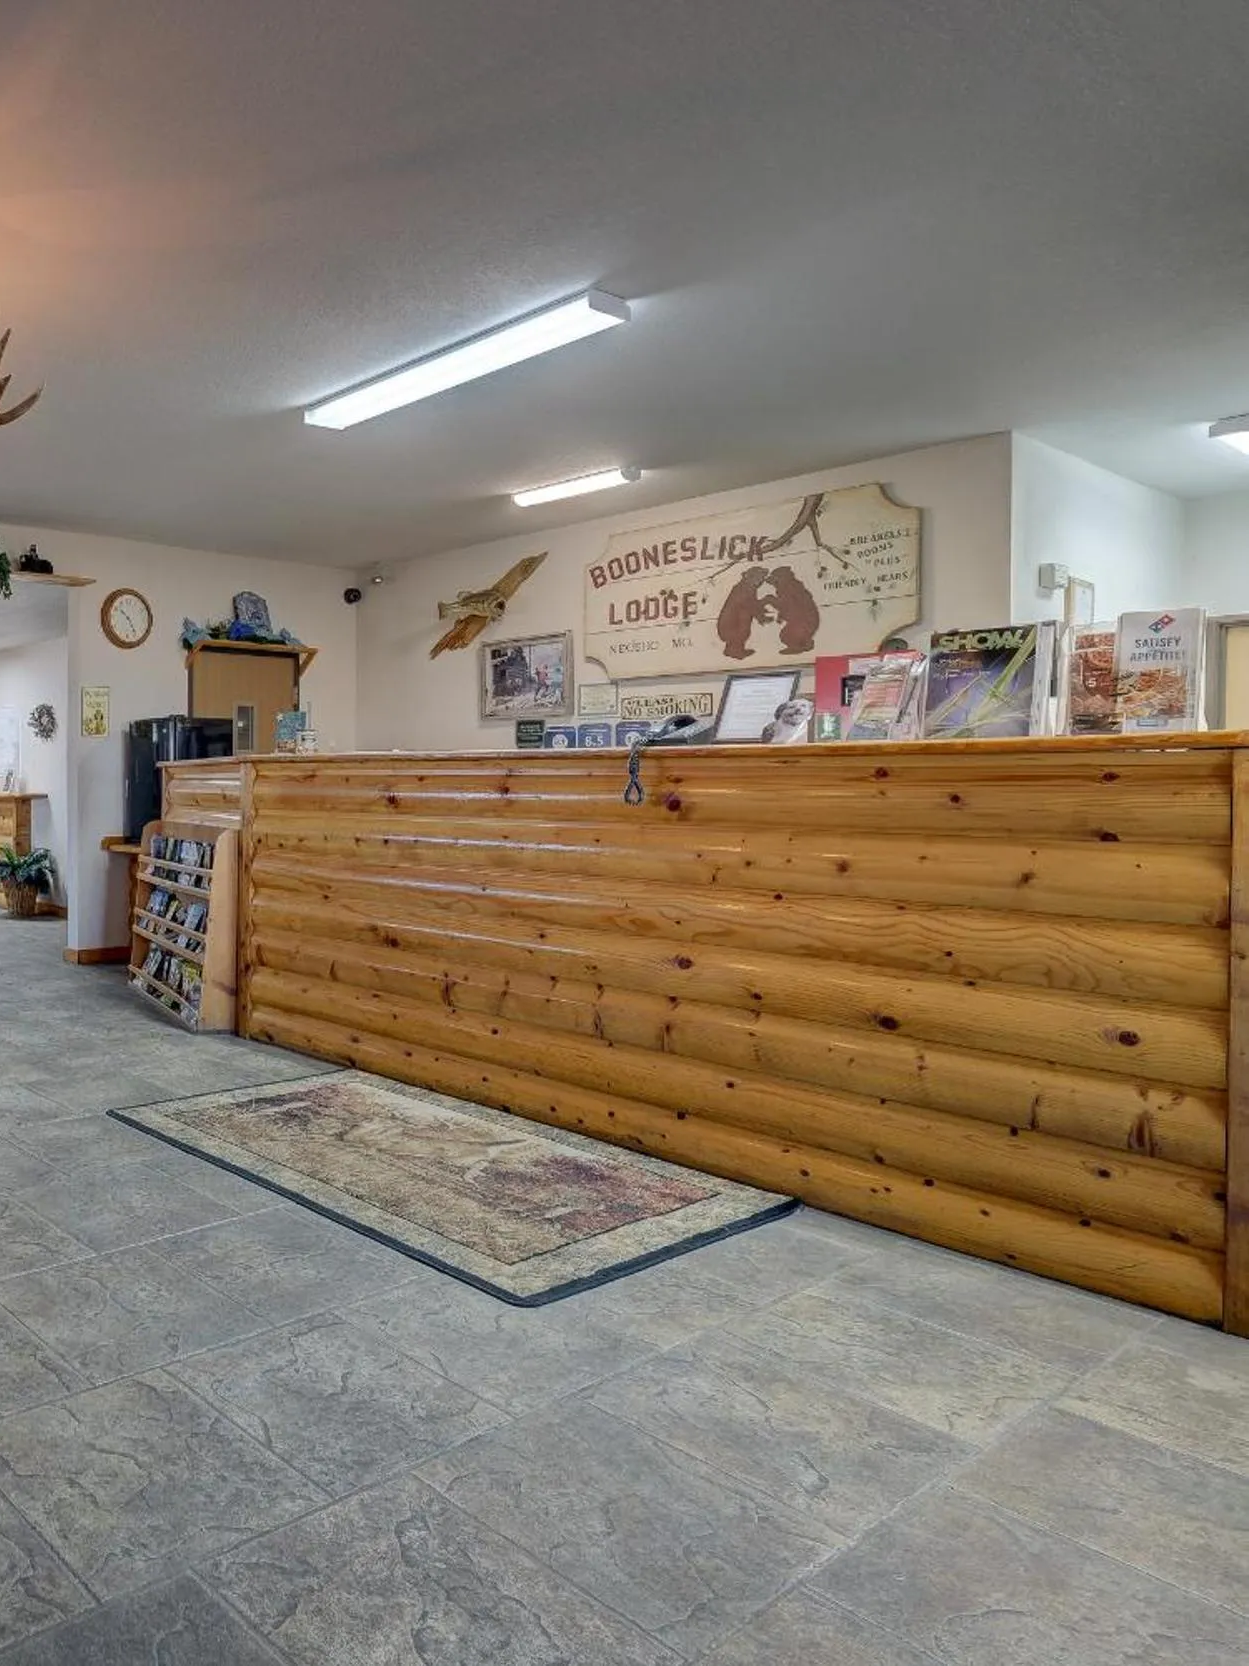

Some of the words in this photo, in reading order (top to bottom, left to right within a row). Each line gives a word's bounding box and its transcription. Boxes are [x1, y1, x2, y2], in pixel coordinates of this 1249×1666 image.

[589, 534, 770, 589] BOONESLICK
[608, 591, 698, 626] LODGE
[1134, 637, 1182, 649] SATISFY
[646, 694, 709, 716] SMOKING
